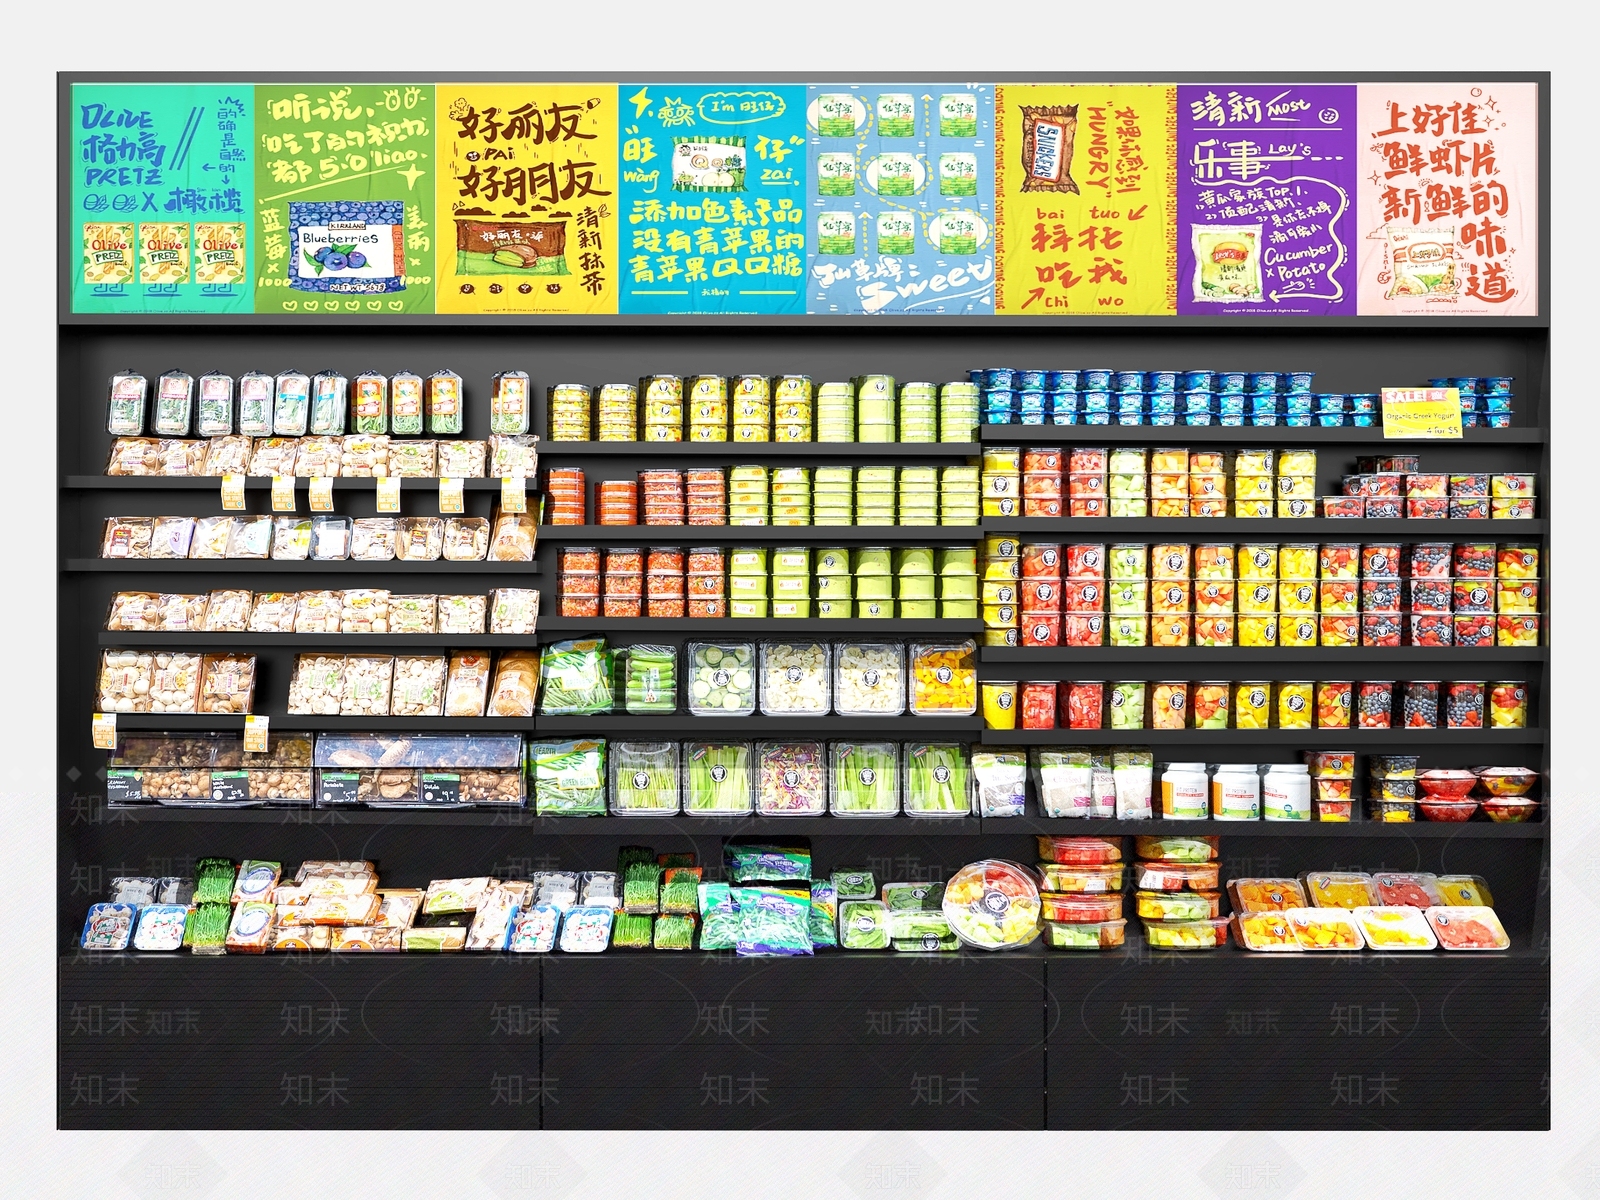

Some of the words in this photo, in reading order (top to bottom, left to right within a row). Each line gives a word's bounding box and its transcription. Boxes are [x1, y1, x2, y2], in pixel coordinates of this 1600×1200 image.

[1190, 91, 1263, 127] 清新
[1377, 102, 1487, 138] 上好佳
[457, 103, 598, 145] 好丽友
[83, 132, 166, 167] 格力高
[1034, 124, 1059, 179] SNICKERS
[1194, 139, 1266, 180] 乐事
[1268, 143, 1312, 157] Lay's
[1384, 140, 1497, 180] 鲜虾片
[86, 167, 164, 186] PRETZ
[271, 160, 313, 184] 都
[457, 159, 612, 205] 好朋友
[164, 187, 245, 214] 橄榄
[628, 197, 803, 227] 添加色素产品
[1036, 208, 1064, 219] bai
[1089, 206, 1120, 219] tuo
[1381, 180, 1509, 225] 新鲜的
[92, 239, 127, 250] Olive
[147, 239, 183, 250] Olive
[203, 239, 238, 250] Olive
[260, 208, 286, 261] 蓝莓
[303, 233, 379, 245] Blueberries
[632, 227, 805, 255] 没有青苹果的
[576, 206, 606, 295] 清新抹茶
[1264, 243, 1333, 267] Cucumber
[1461, 216, 1515, 303] 味道
[400, 275, 431, 286] 1000
[628, 252, 803, 283] 青苹果QQ糖
[1277, 262, 1326, 282] Potato
[258, 277, 292, 287] 1000
[330, 284, 348, 292] NET
[858, 258, 993, 315] Sweet
[1385, 390, 1427, 403] SALE!
[1448, 426, 1458, 434] $5
